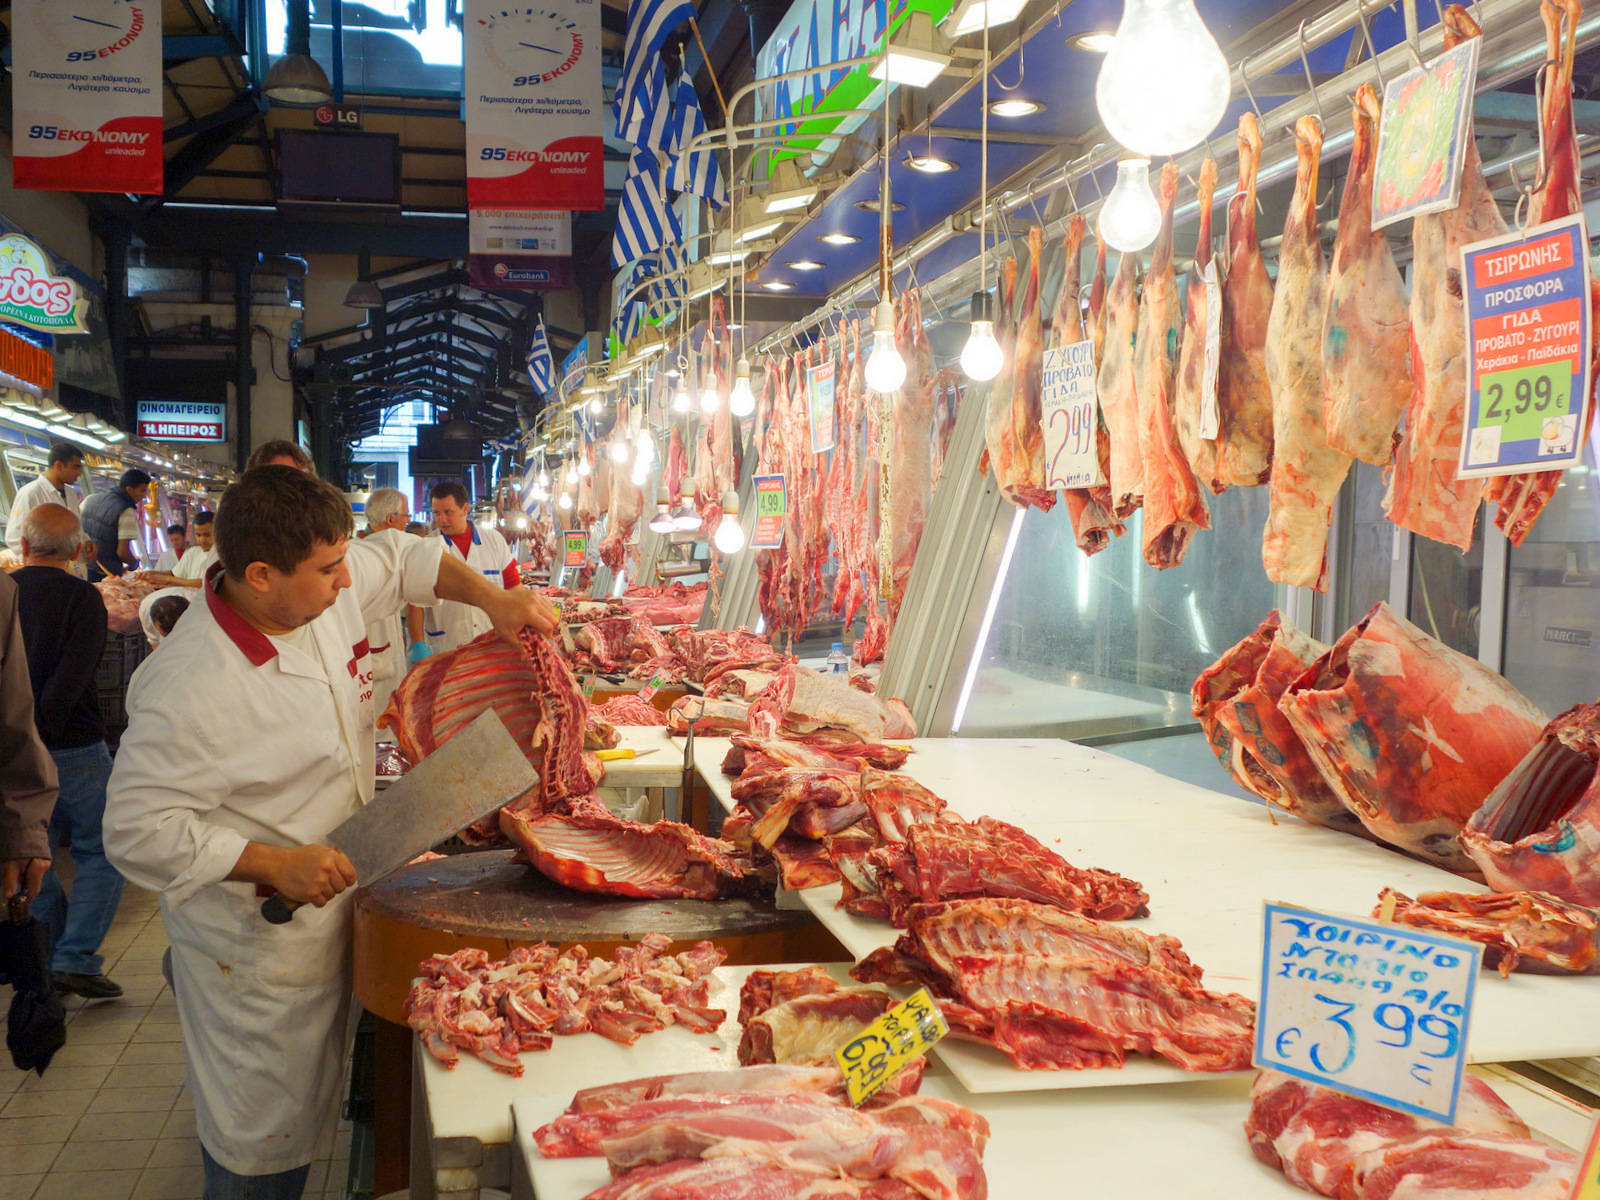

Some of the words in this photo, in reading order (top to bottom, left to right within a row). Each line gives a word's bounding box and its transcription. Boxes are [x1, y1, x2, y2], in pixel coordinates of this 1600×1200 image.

[29, 70, 89, 82] Περισσότερα
[67, 82, 110, 93] Λιγότερα
[479, 95, 533, 105] Περισσότερα
[337, 110, 358, 123] LG
[514, 105, 554, 115] Λιγότερα
[28, 125, 150, 145] 95EKONOMY
[104, 147, 146, 157] unleaded
[480, 147, 590, 163] 95EKONOMY
[549, 166, 587, 175] unleaded
[476, 210, 502, 218] 5.000
[1485, 243, 1562, 277] ΤΣΙΡΩΝΗΣ
[508, 271, 545, 280] Eurobank
[1485, 277, 1564, 308] ΠΡΟΣΦΟΡΑ
[28, 314, 75, 325] ΚΟΤΟΠΟΥΛΑ
[1502, 309, 1543, 330] ΓΙΔΑ
[1475, 331, 1526, 354] ΠΡΟΒΑΤΟ
[1533, 320, 1580, 344] ΖΥΓΟΥΡΙ
[1476, 354, 1519, 371] Χεράκια
[1527, 343, 1579, 362] Παϊδάκια
[1043, 364, 1093, 388] ΠΡΟΒΑΤΟ
[1043, 381, 1078, 401] ΓΙΔΑ
[1485, 375, 1553, 423] 2,99
[1555, 393, 1564, 409] €
[140, 403, 220, 415] ΟΙΝΟΜΑΓΕΙΡΕΙΟ
[760, 494, 778, 515] 4,99
[568, 540, 582, 551] 4,99
[1545, 629, 1577, 642] PERFECT
[1280, 918, 1461, 968] ΧΟΙΡΙΝΟ
